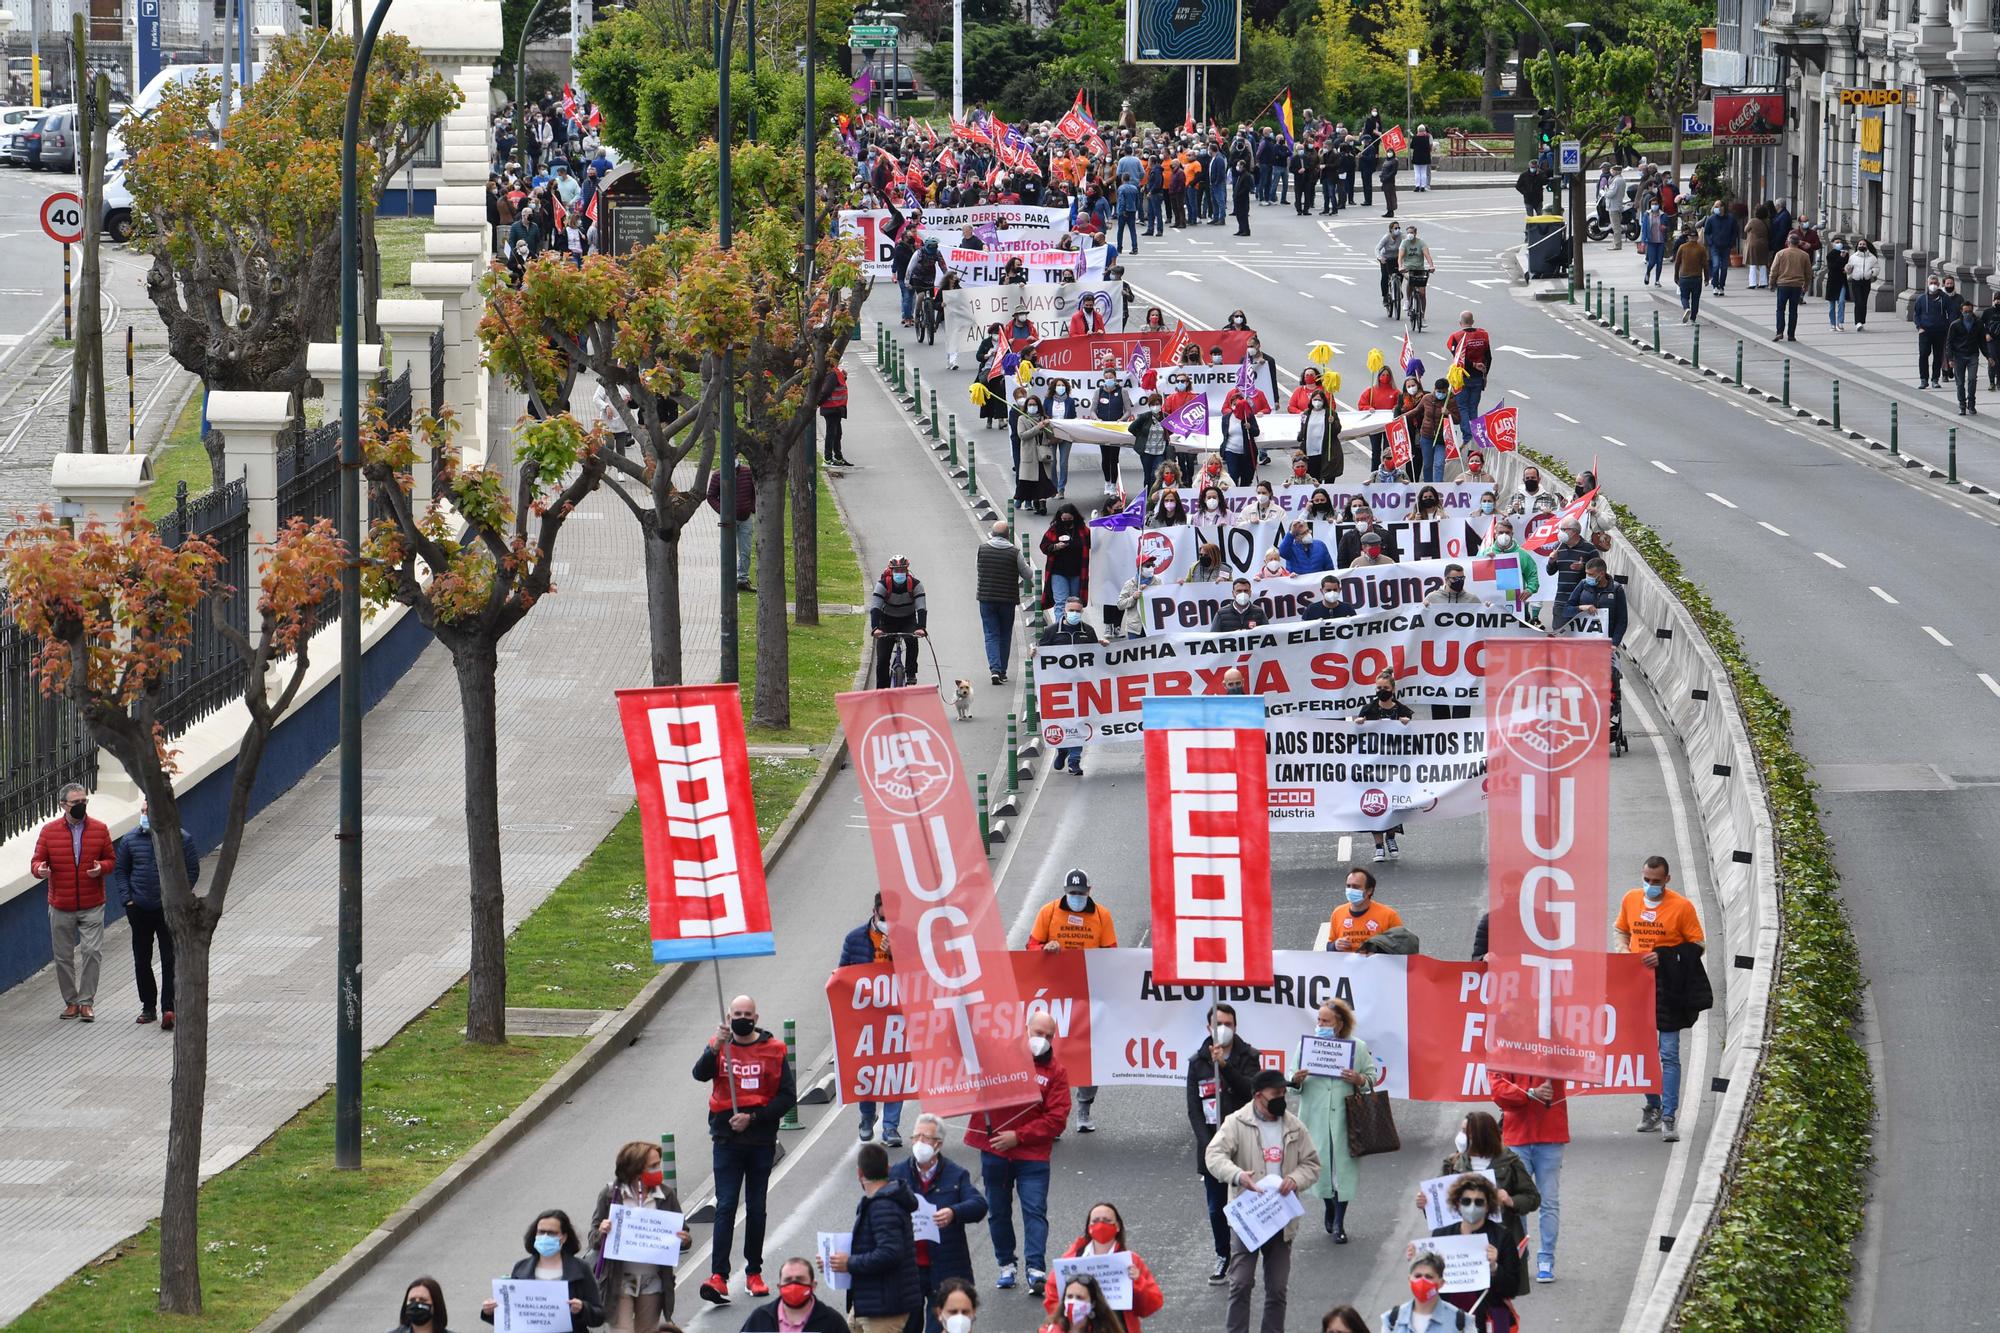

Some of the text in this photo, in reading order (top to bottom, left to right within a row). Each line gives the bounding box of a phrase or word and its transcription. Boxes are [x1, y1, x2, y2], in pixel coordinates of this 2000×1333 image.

[146, 3, 154, 15] P
[151, 21, 159, 47] Parking
[1841, 90, 1901, 105] POMBO
[51, 209, 79, 226] 40
[1025, 213, 1050, 223] PARA
[991, 297, 1008, 312] DE
[1020, 296, 1065, 311] MAYO
[1494, 417, 1517, 434] UGT
[1371, 492, 1400, 509] NO
[1041, 652, 1095, 671] POR
[1105, 642, 1177, 667] UNHA
[1185, 635, 1278, 657] TARIFA
[1287, 614, 1426, 645] ELÉCTRICA
[1040, 653, 1291, 720] ENERXÍA
[1454, 686, 1479, 699] DE
[1510, 684, 1585, 727] UGT
[871, 729, 932, 772] UGT
[1275, 731, 1308, 755] AOS
[1312, 731, 1459, 756] DESPEDIMENTOS
[1464, 731, 1485, 754] EN
[1275, 763, 1347, 783] (ANTIGO
[1351, 763, 1412, 783] GRUPO
[1361, 792, 1412, 805] UGT FICA
[1167, 730, 1245, 980] CCOO
[853, 1024, 874, 1058] A
[1496, 1038, 1597, 1060] www.ugtgalicia.org
[1125, 1037, 1178, 1071] CIG
[926, 1069, 1029, 1097] www.ugtgalicia.org
[627, 1223, 673, 1235] TRABALLADORA
[634, 1232, 662, 1242] ESENCIAL
[625, 1239, 670, 1251] SON CELADORA
